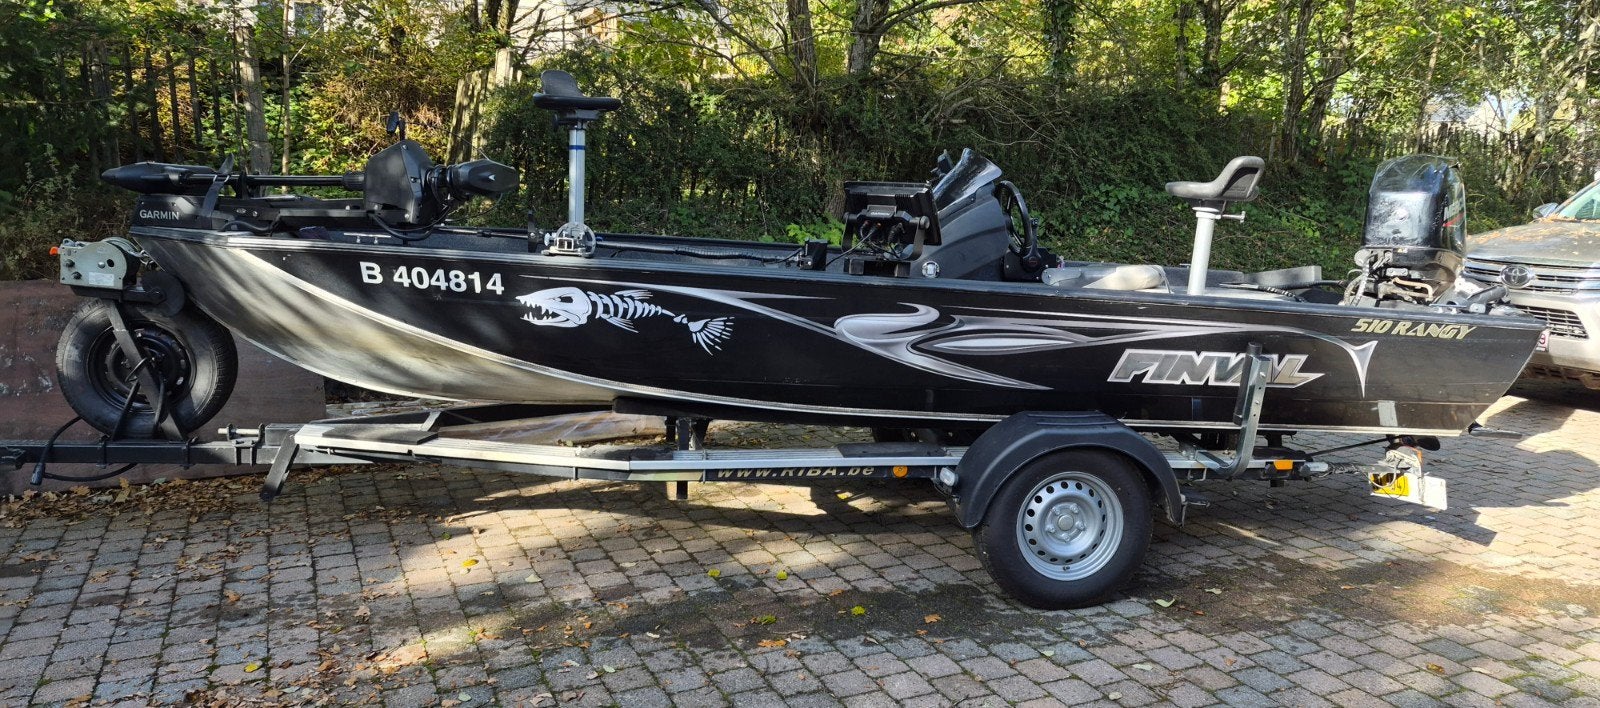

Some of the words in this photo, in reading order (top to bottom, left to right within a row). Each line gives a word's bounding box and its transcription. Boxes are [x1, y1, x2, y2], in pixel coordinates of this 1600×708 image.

[139, 209, 180, 220] GARMIN
[359, 261, 384, 285] B
[393, 265, 505, 295] 404814
[1351, 318, 1393, 334] 510
[1391, 321, 1477, 340] RANGY
